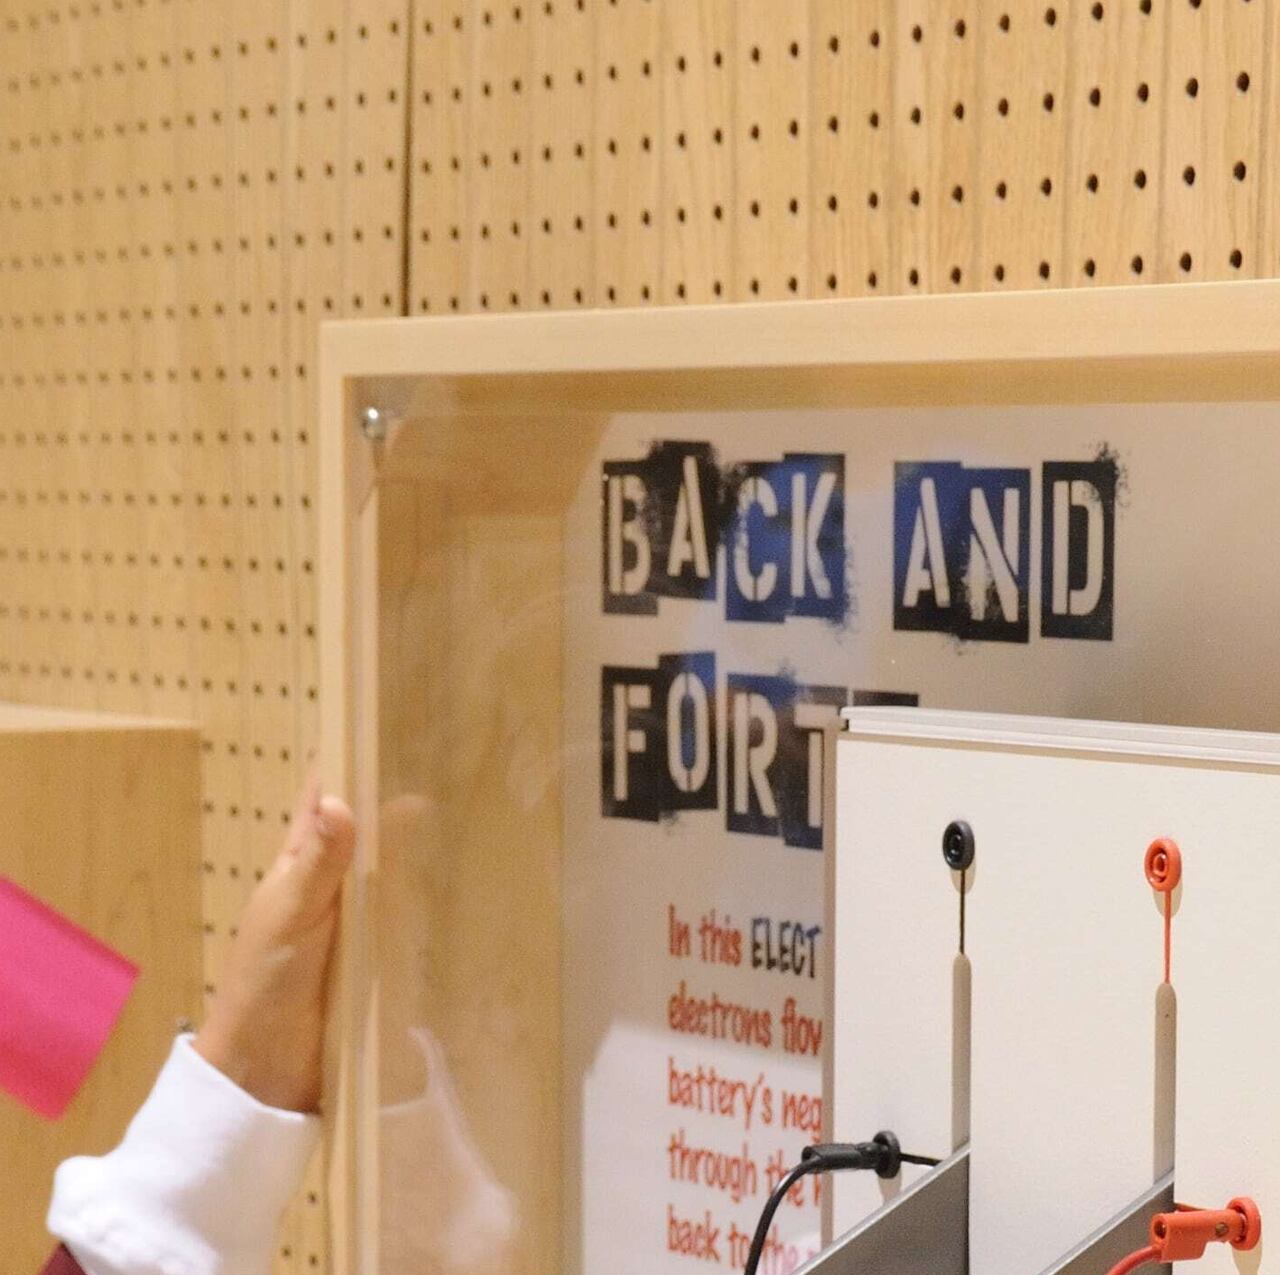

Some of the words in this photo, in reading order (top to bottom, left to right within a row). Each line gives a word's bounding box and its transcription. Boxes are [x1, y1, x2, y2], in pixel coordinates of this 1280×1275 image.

[609, 455, 837, 602] BACK
[902, 470, 1106, 624] AND
[613, 672, 846, 830] FORT
[669, 903, 691, 959] In
[700, 908, 743, 967] this
[751, 917, 822, 979] ELECT
[667, 978, 772, 1049] electrons
[666, 1056, 774, 1131] battery's
[666, 1128, 758, 1204] through
[666, 1204, 721, 1262] back
[728, 1222, 750, 1271] to
